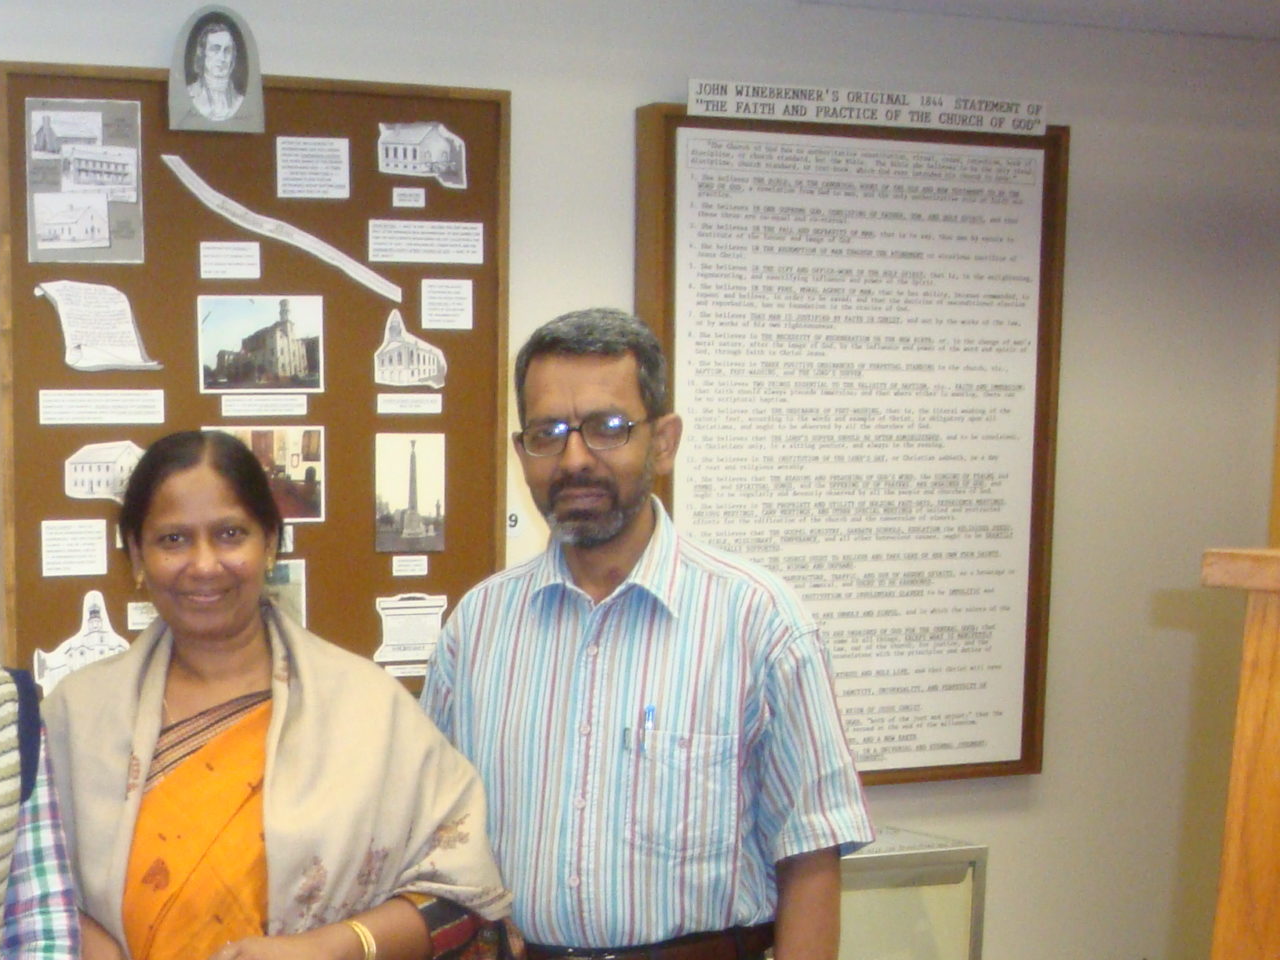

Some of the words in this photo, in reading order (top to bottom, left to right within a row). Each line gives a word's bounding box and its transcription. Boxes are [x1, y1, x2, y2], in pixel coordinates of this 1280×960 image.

[696, 83, 728, 96] JOHN
[735, 85, 839, 103] WINEBRENNER'S
[847, 91, 909, 106] ORIGINAL
[921, 96, 943, 107] 1844
[954, 98, 1020, 114] STATEMENT
[1027, 104, 1042, 116] OF
[696, 99, 727, 112] "THE
[736, 103, 775, 115] FAITH
[782, 105, 807, 117] AND
[815, 107, 877, 121] PRACTICE
[885, 109, 901, 121] OF
[908, 111, 931, 124] THE
[938, 112, 983, 128] CHURCH
[990, 117, 1004, 129] OF
[1012, 118, 1041, 130] GOD"
[508, 513, 518, 528] 9
